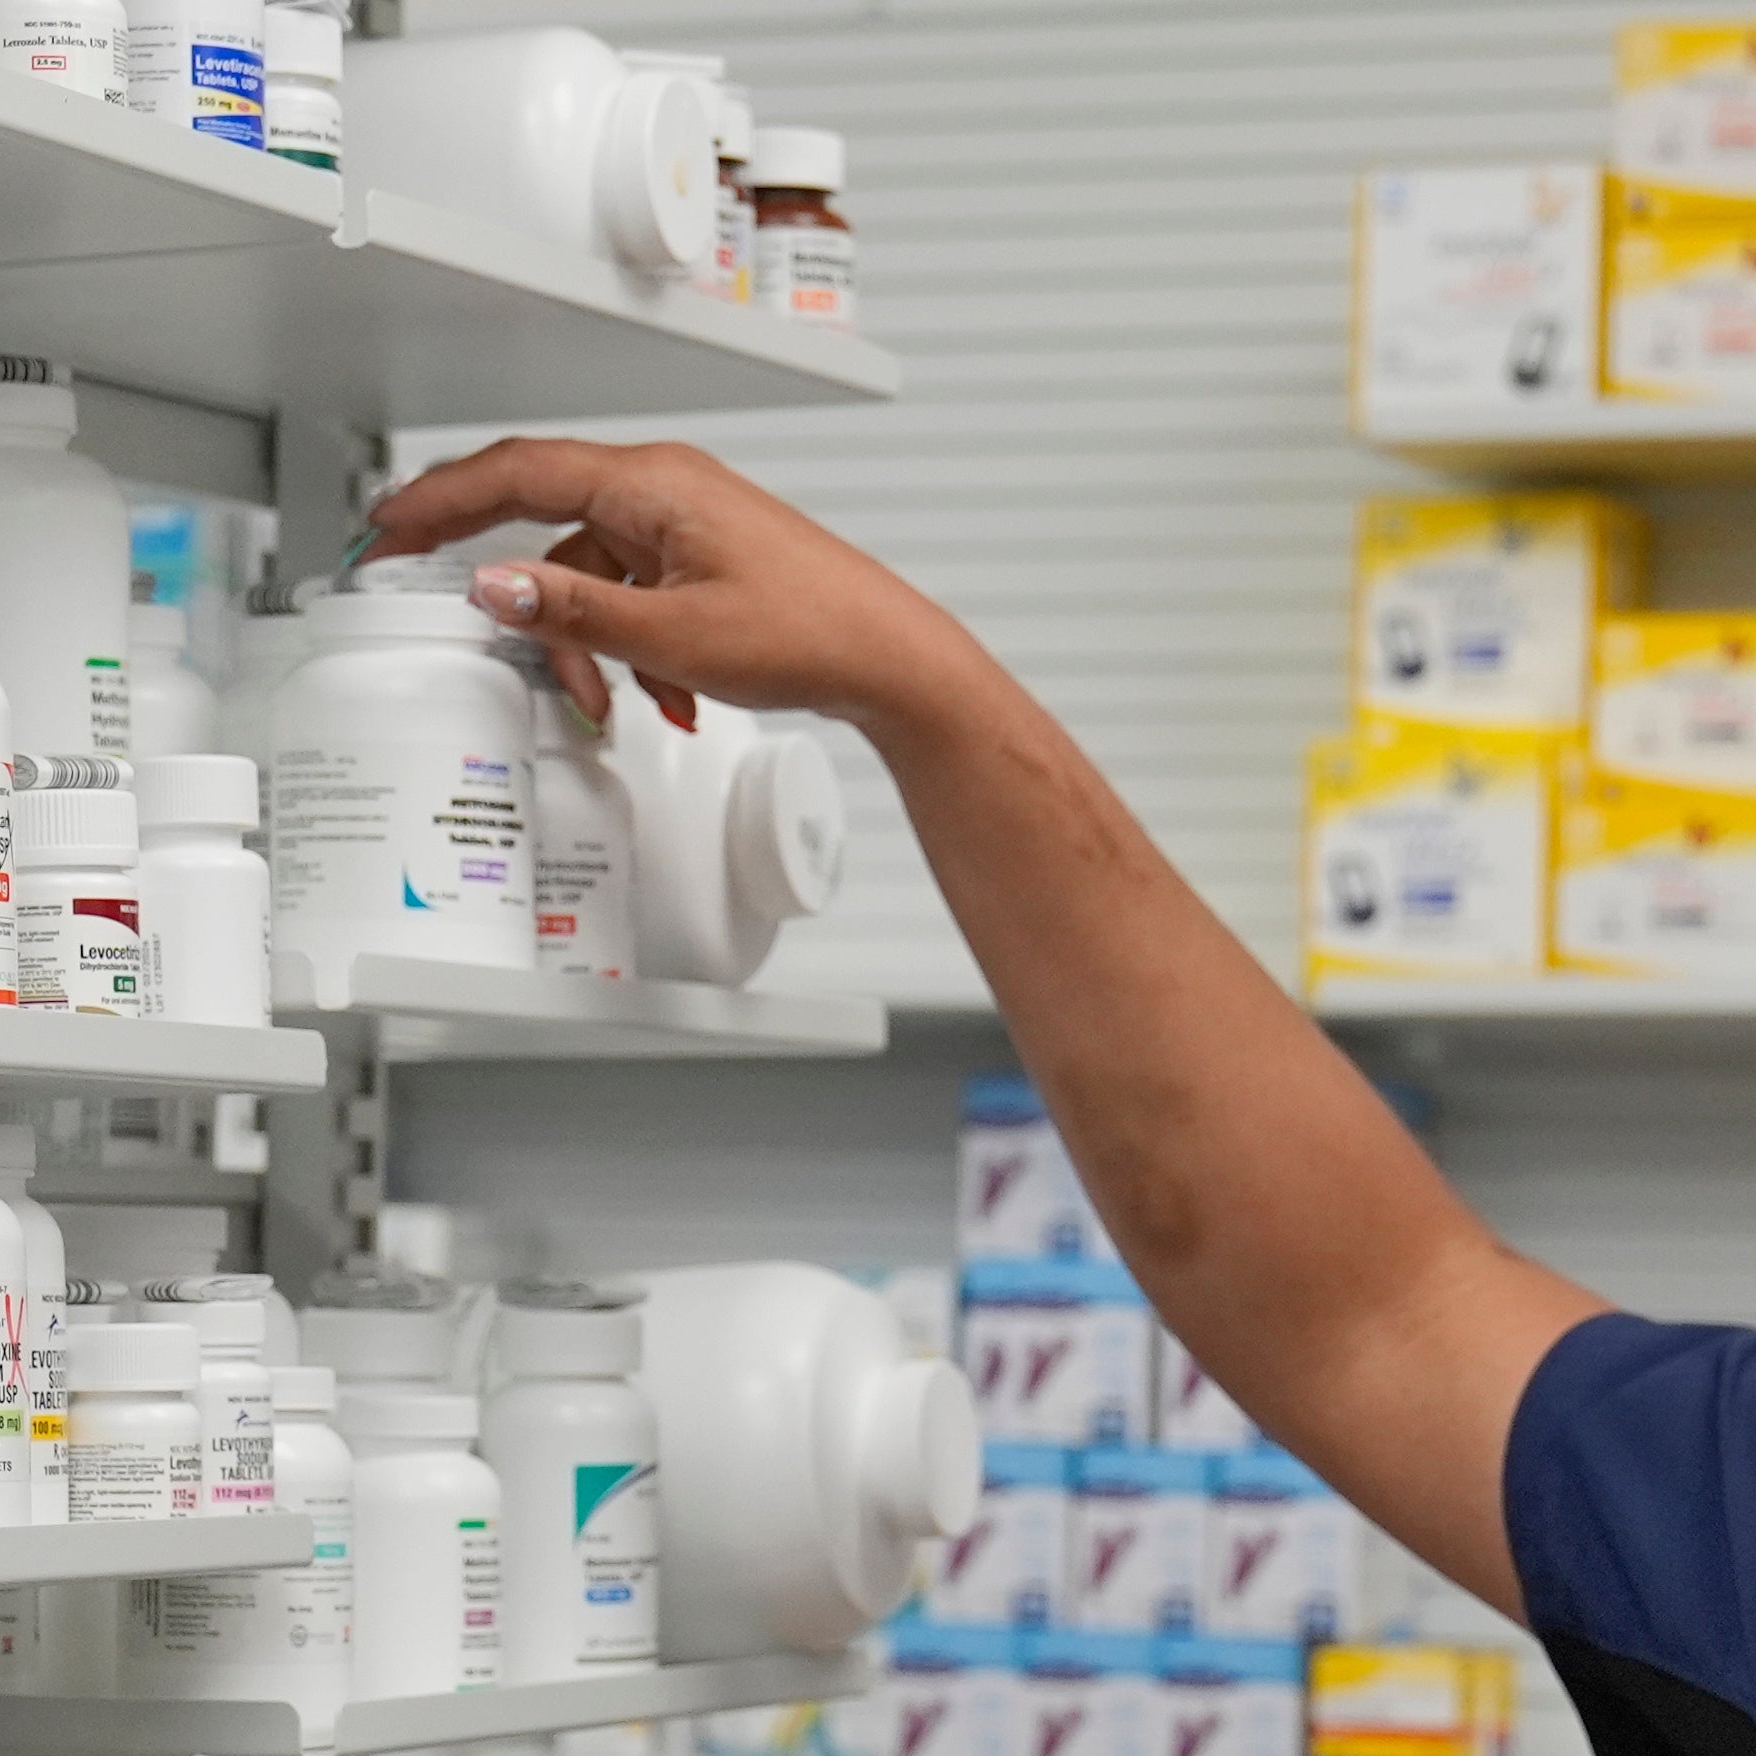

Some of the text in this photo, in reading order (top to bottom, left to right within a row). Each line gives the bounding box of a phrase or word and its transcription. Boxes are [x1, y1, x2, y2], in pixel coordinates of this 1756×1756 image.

[3, 36, 108, 49] Letrozole Tablets, USP
[196, 73, 240, 88] Tablets,
[197, 97, 232, 111] 250 mg
[32, 1422, 48, 1435] 100
